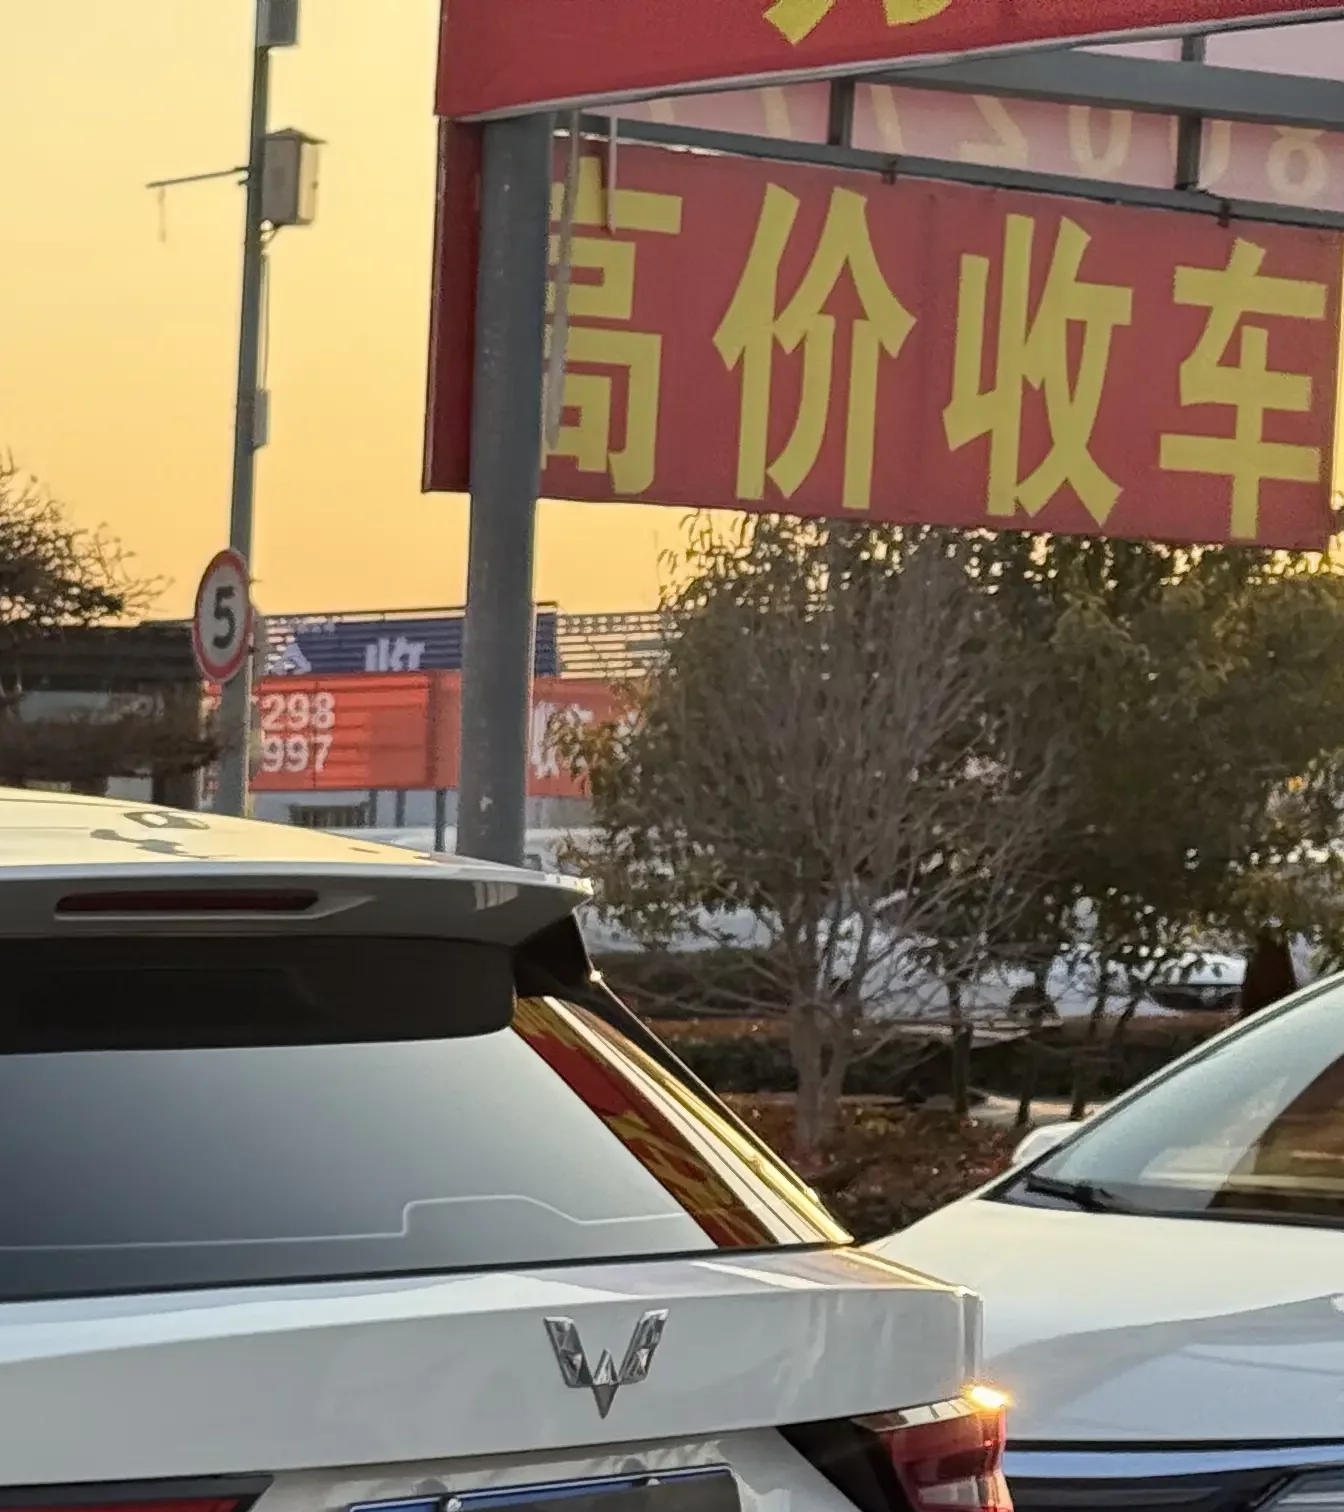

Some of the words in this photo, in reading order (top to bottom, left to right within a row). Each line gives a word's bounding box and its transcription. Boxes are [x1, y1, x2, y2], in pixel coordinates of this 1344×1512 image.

[542, 156, 1327, 540] 高价收车
[214, 586, 236, 648] 5
[251, 691, 336, 731] 298
[260, 730, 333, 773] 997
